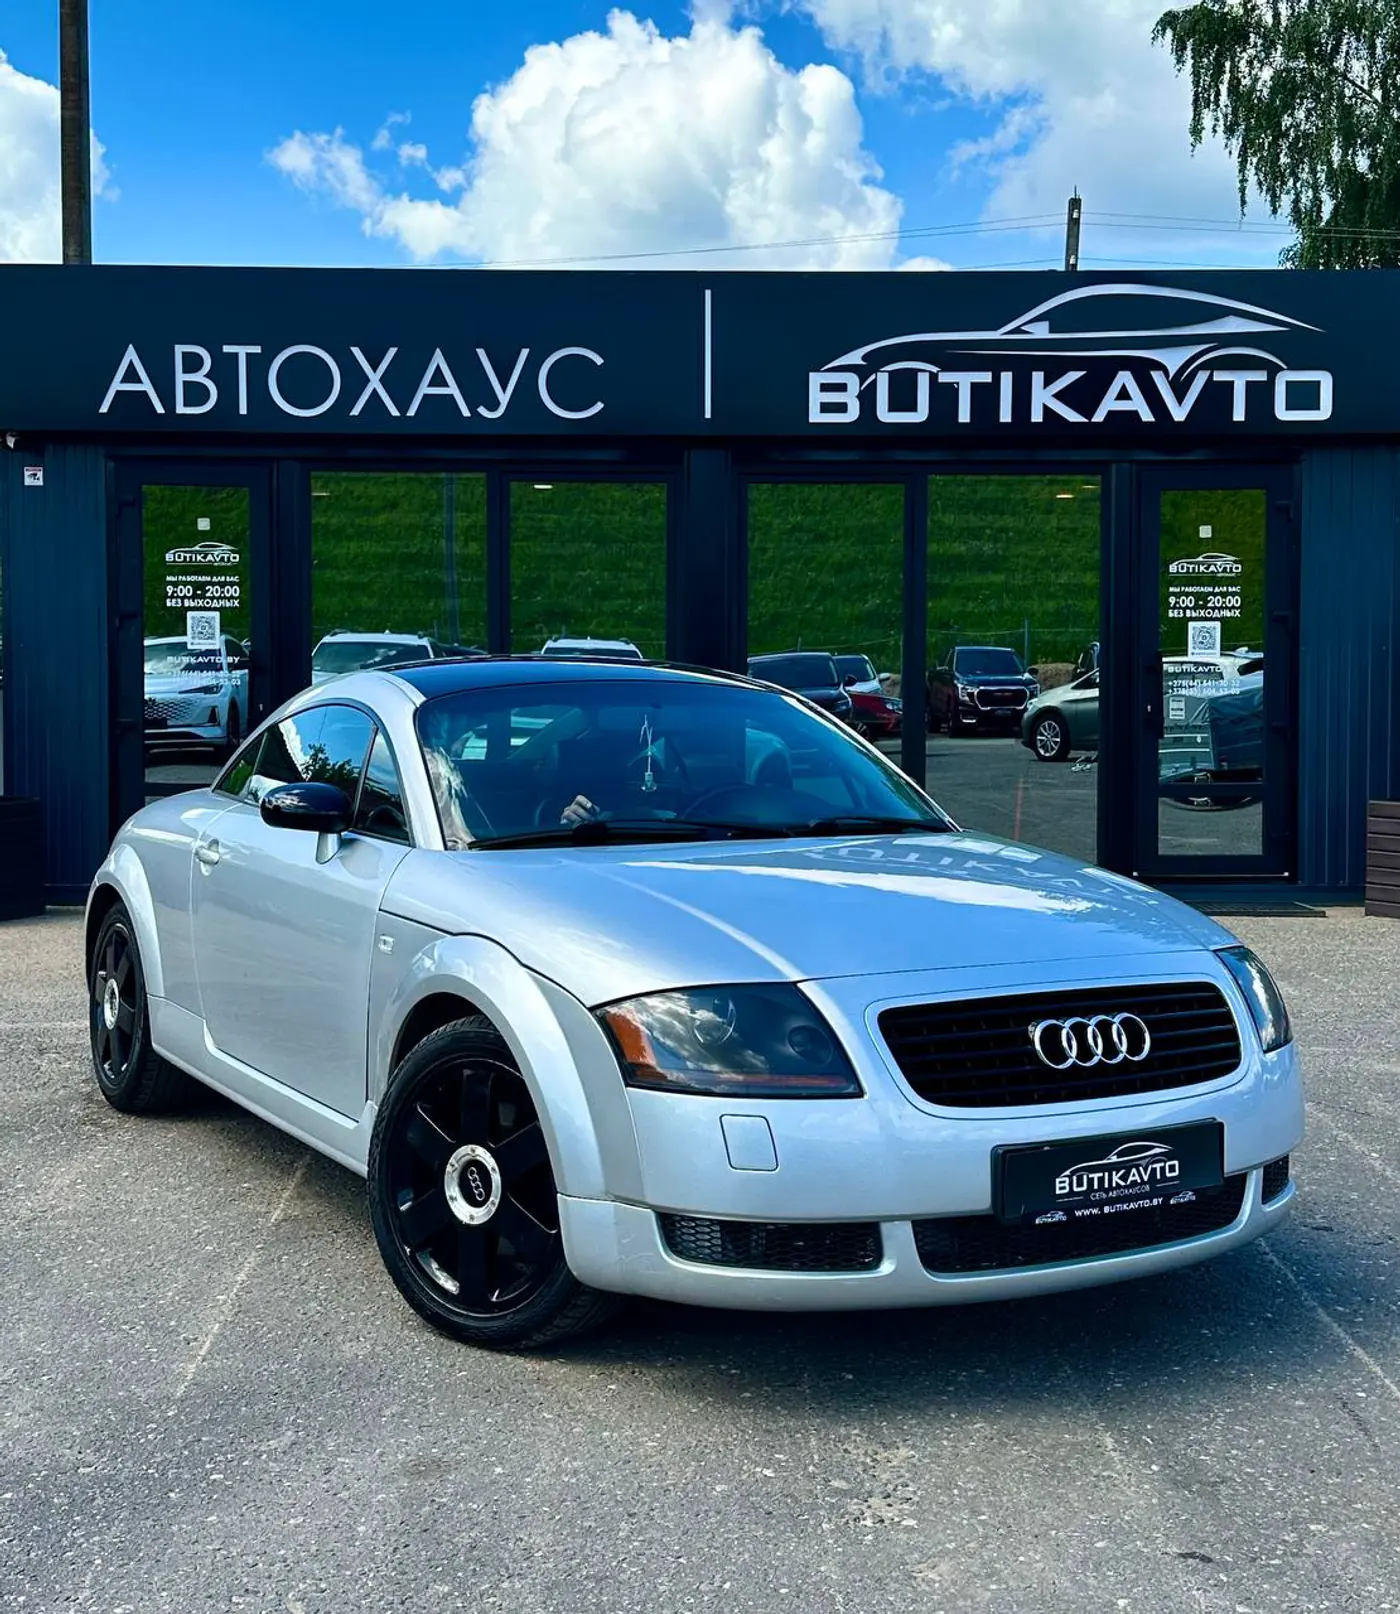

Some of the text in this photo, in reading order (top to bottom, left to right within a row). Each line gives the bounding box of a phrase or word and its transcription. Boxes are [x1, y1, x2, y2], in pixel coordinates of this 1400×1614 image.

[98, 343, 605, 419] АВТОХАУС
[808, 369, 1334, 424] BUTIKAVTO
[165, 553, 240, 562] BUTIKAVTO
[1169, 563, 1242, 573] BUTIKAVTO
[166, 585, 193, 597] 9:00
[205, 585, 241, 597] 20:00
[166, 599, 240, 608] БЕЗ ВЫХОДНЫХ
[1168, 596, 1195, 607] 9:00
[1207, 596, 1241, 607] 20:00
[1168, 609, 1241, 618] БЕЗ ВЫХОДНЫХ
[1055, 1160, 1180, 1195] BUTIKAVTO
[1089, 1191, 1107, 1201] СЕТЬ
[1103, 1197, 1163, 1213] BUTIKAVTO.BY
